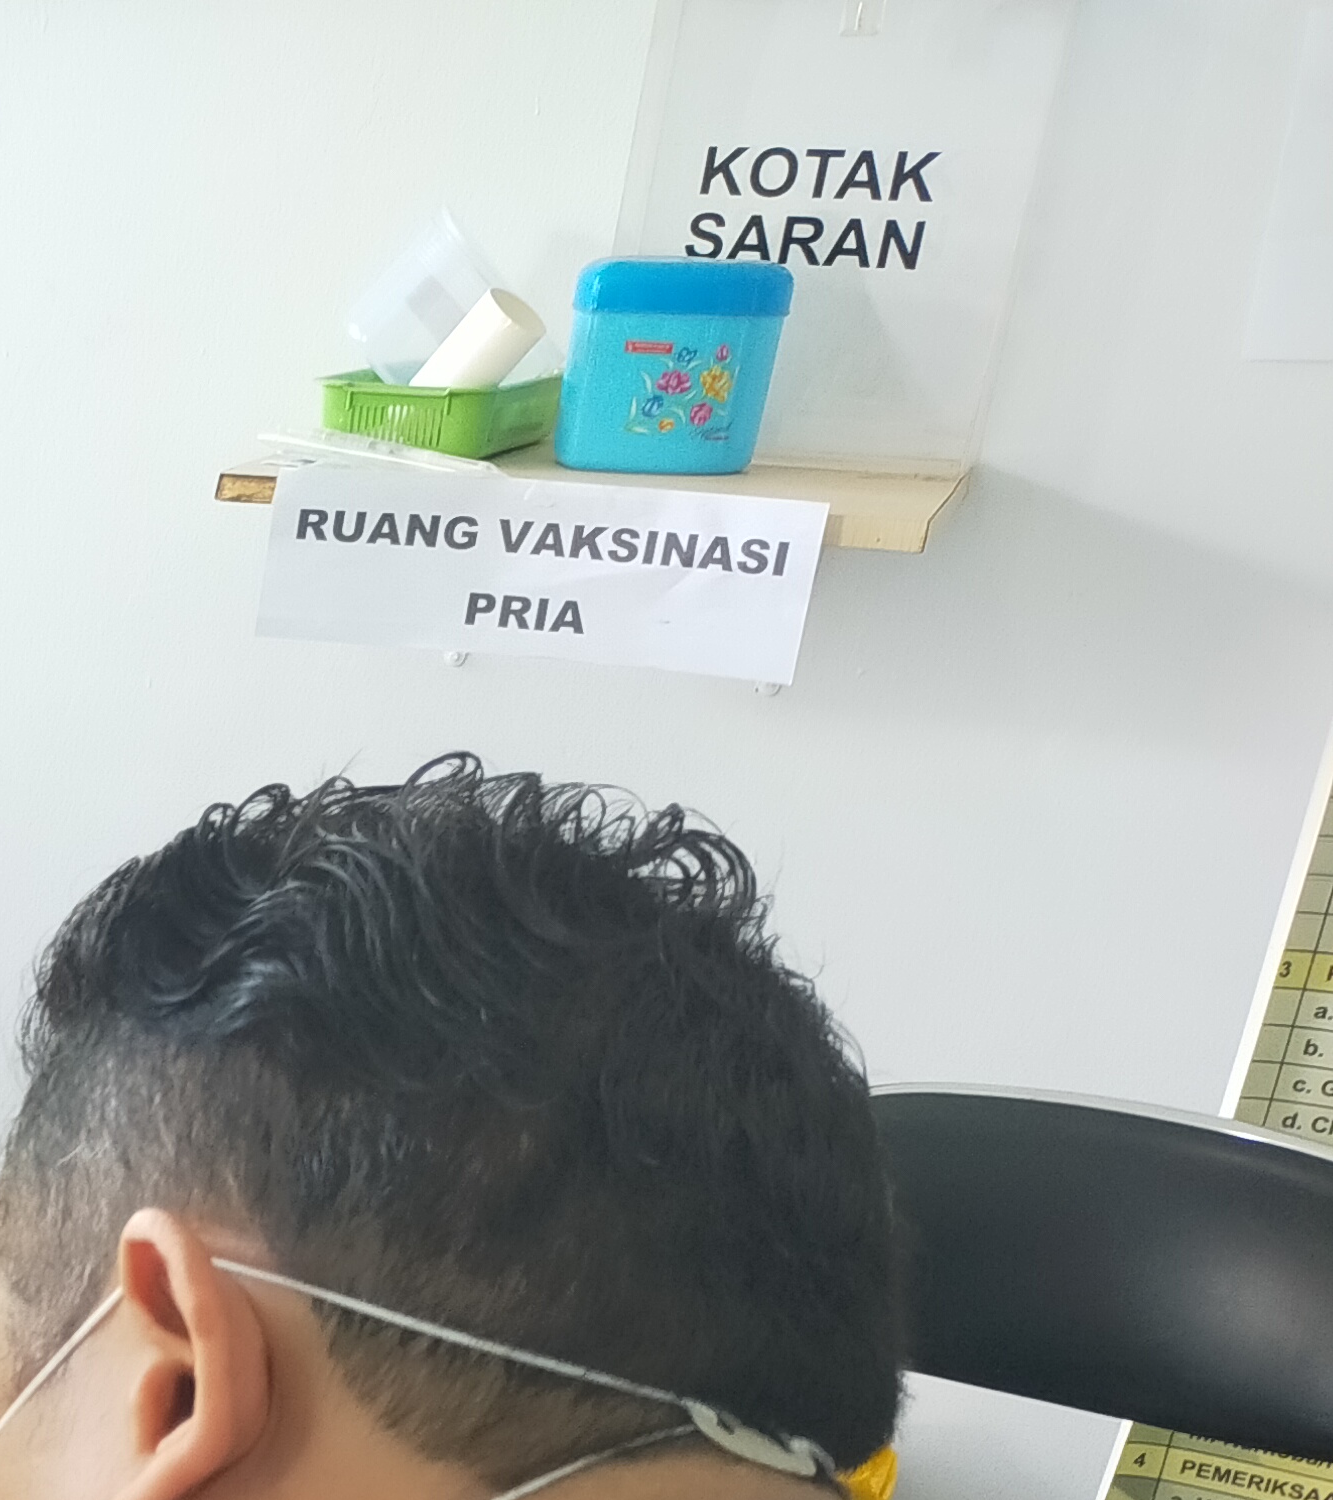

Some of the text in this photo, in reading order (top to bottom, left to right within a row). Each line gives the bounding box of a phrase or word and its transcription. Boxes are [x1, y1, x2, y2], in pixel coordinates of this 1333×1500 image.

[699, 146, 942, 202] KOTAK
[684, 212, 926, 270] SARAN
[294, 508, 791, 577] RUANG VAKSINASI
[464, 592, 585, 635] PRIA
[1279, 960, 1292, 978] 3
[1303, 1038, 1324, 1058] b.
[1292, 1079, 1312, 1094] c.
[1281, 1112, 1302, 1130] d.
[1133, 1452, 1146, 1468] 4
